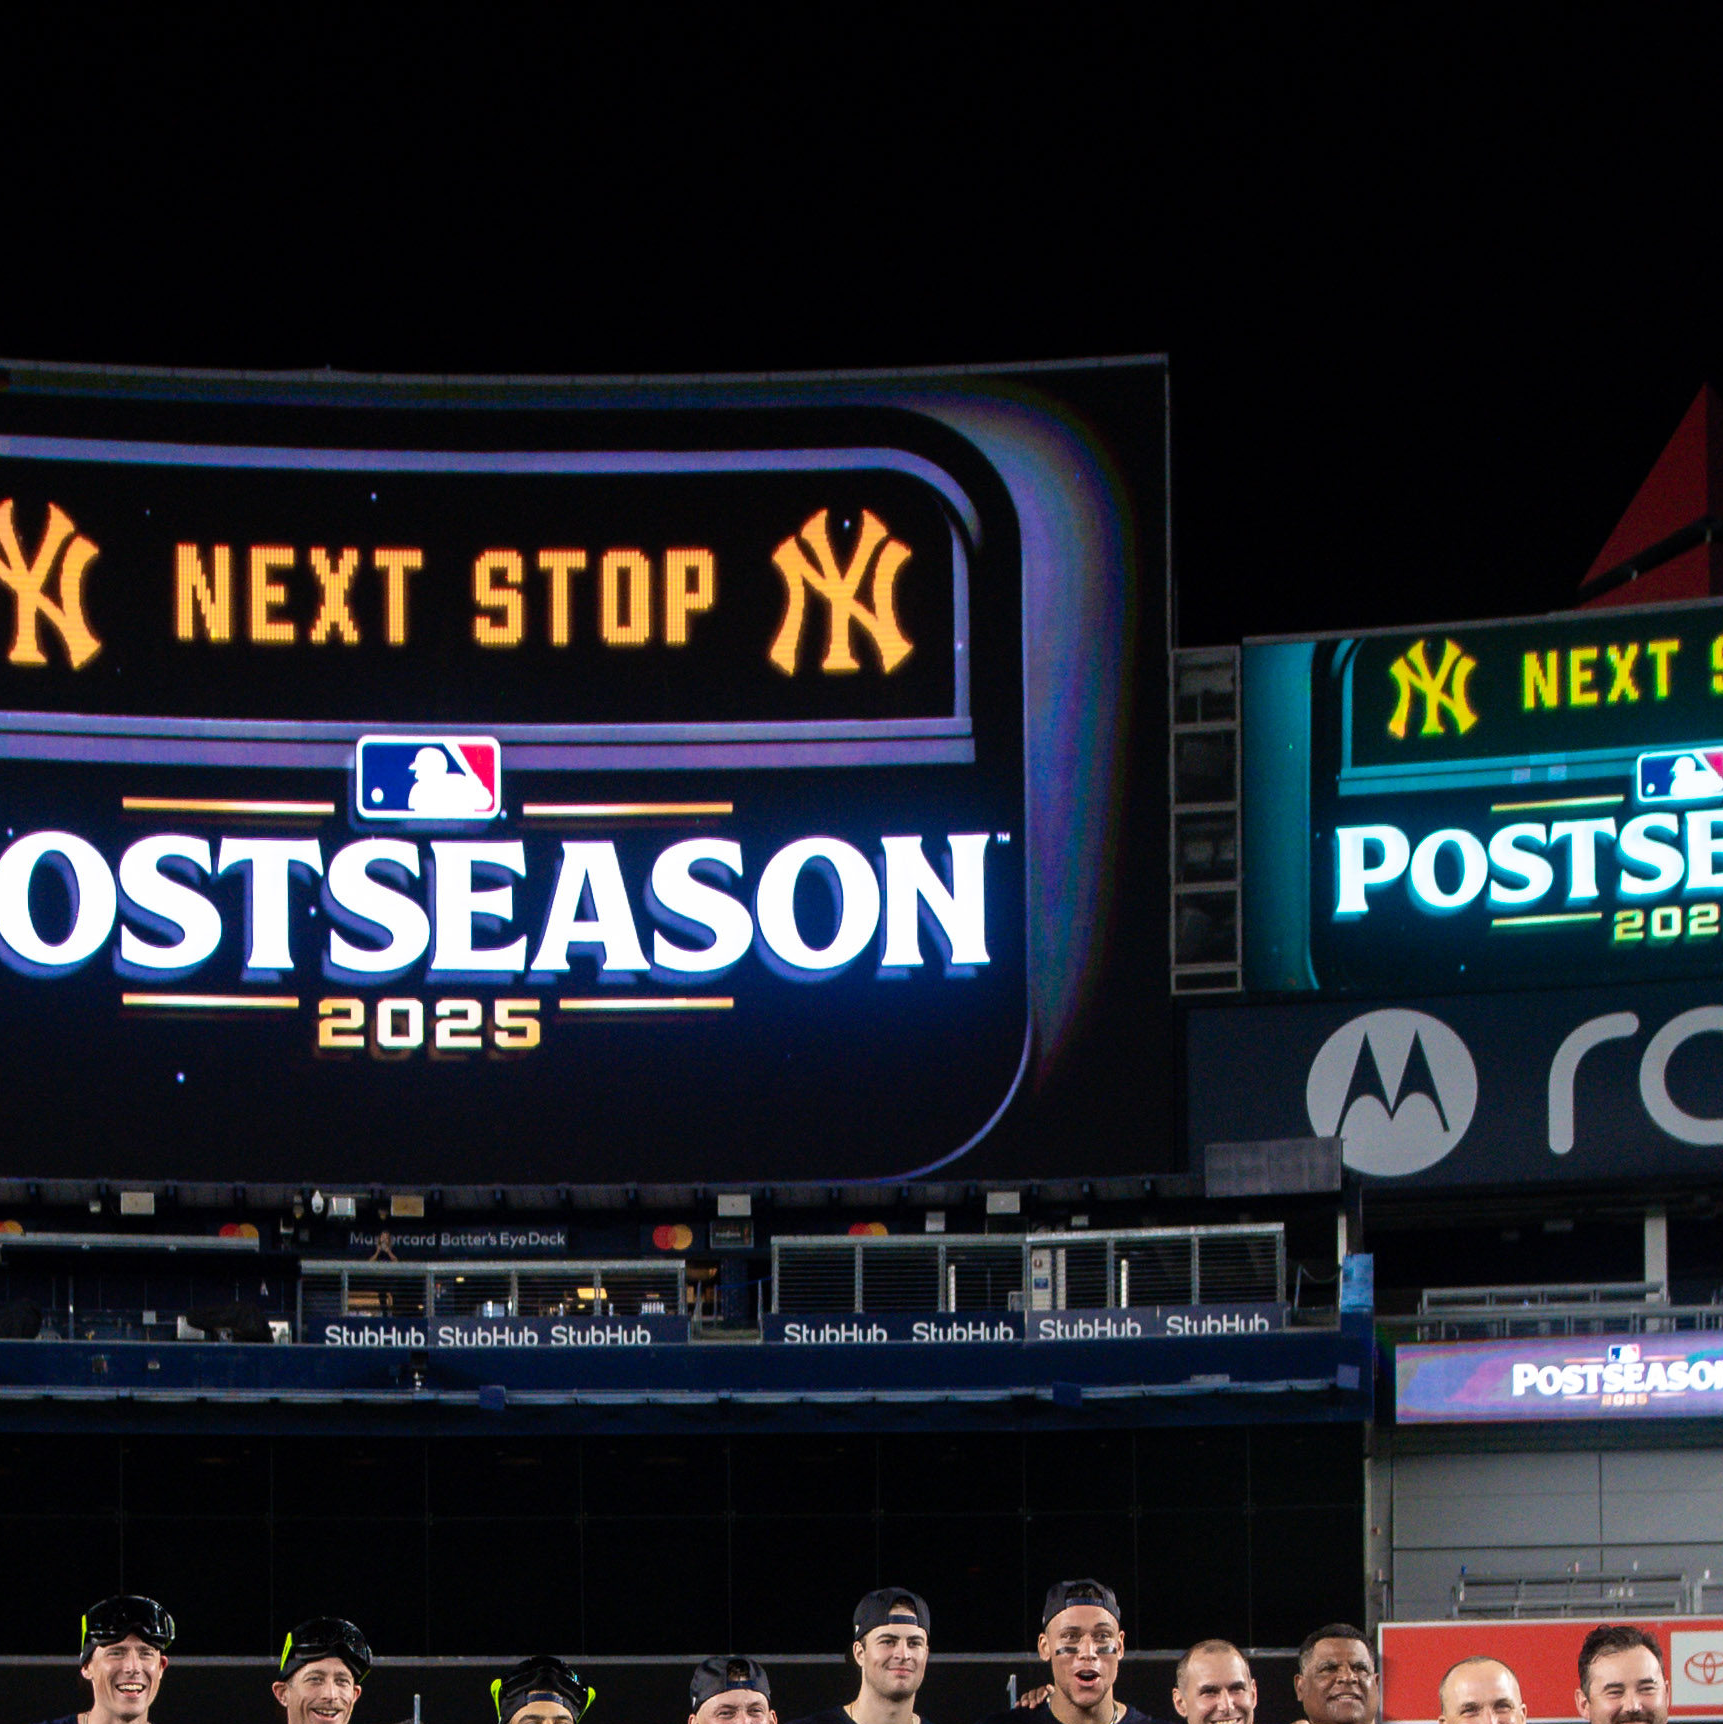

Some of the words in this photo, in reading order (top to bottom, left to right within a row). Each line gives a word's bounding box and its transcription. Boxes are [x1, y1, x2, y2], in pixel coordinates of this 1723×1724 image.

[173, 542, 424, 648] NEXT
[474, 547, 716, 650] STOP
[1523, 640, 1678, 711] NEXT
[318, 998, 541, 1049] 2025
[350, 1231, 435, 1246] Masercard
[441, 1231, 497, 1246] Batter's
[500, 1232, 527, 1248] Eye
[528, 1231, 566, 1246] Deck
[324, 1324, 426, 1347] StubHub
[438, 1325, 539, 1347] StubHub
[551, 1324, 651, 1346] StubHub
[783, 1322, 888, 1344] StubHub
[912, 1321, 1014, 1342] StubHub
[1039, 1317, 1142, 1340] StubHub
[1166, 1313, 1269, 1337] StubHub
